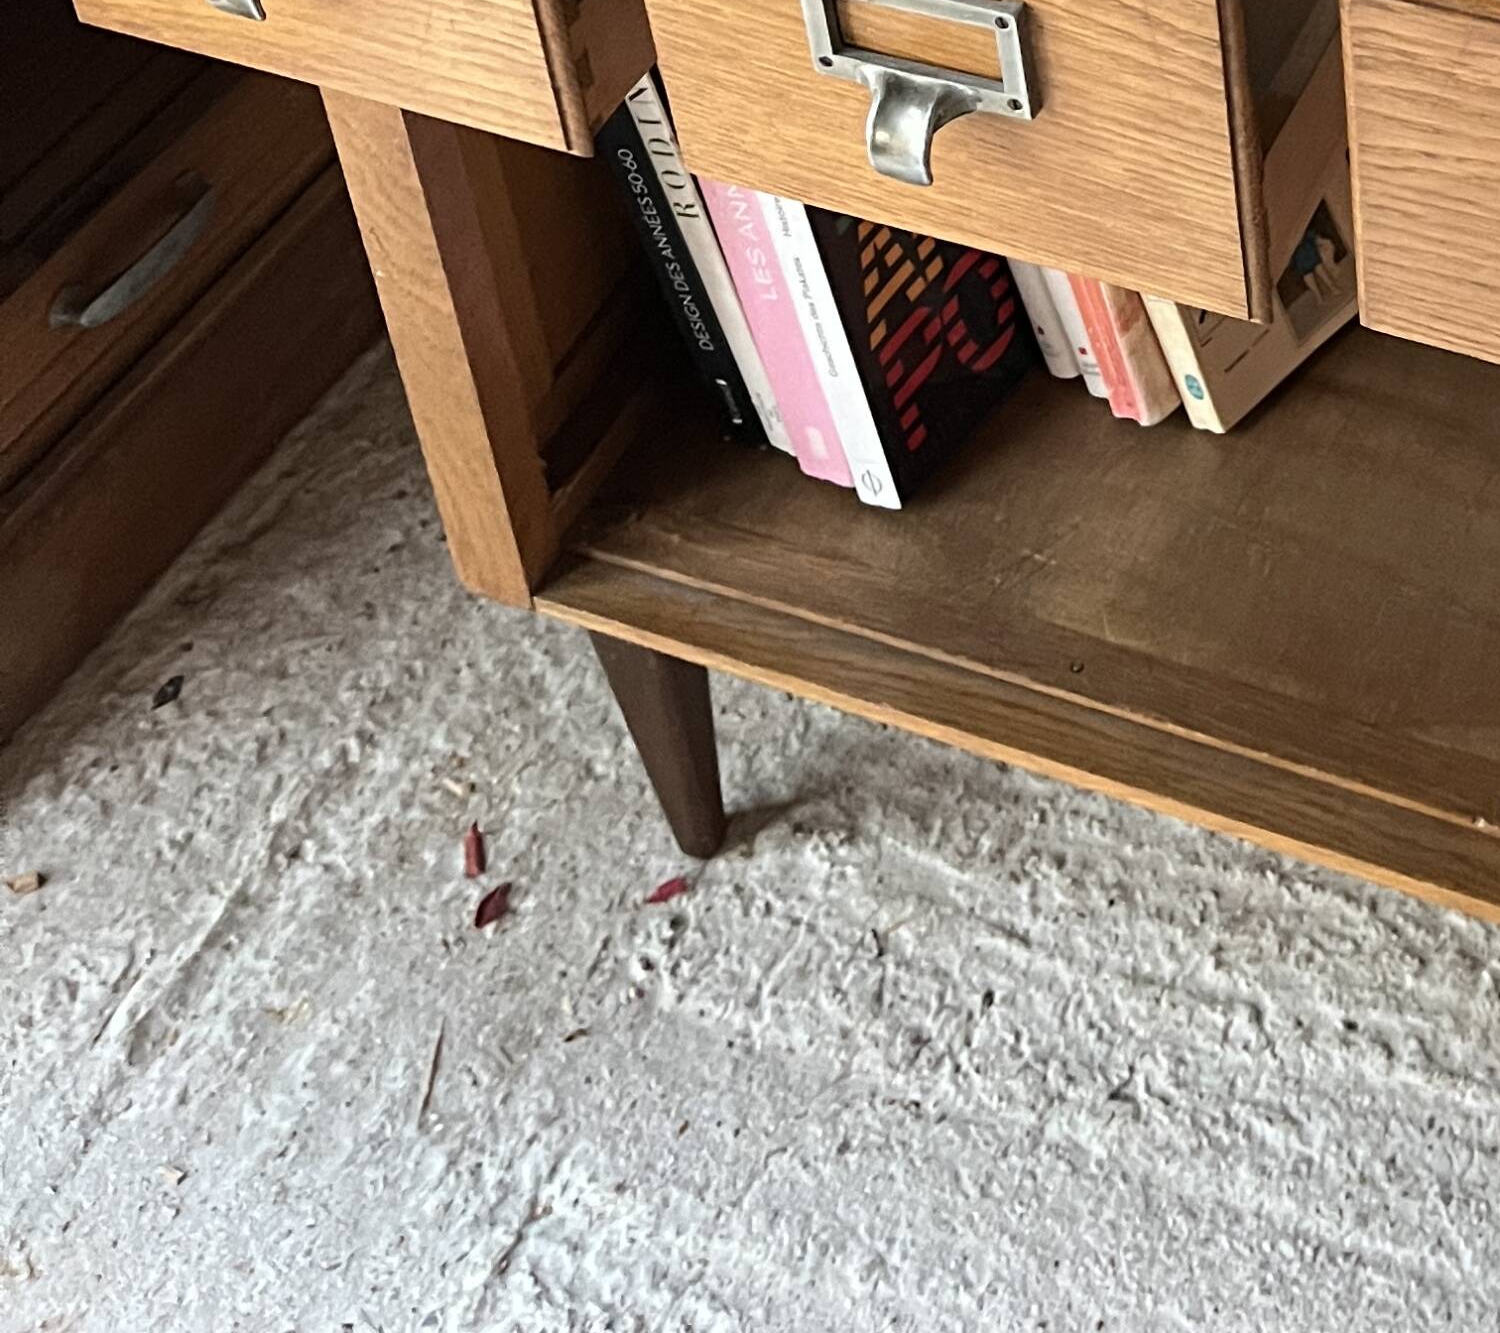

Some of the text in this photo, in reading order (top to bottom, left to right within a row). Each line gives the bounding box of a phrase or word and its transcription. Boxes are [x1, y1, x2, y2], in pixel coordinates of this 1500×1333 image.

[628, 86, 701, 219] RODIN
[665, 261, 690, 292] DES
[745, 245, 780, 302] LES
[679, 294, 715, 351] DESIGN
